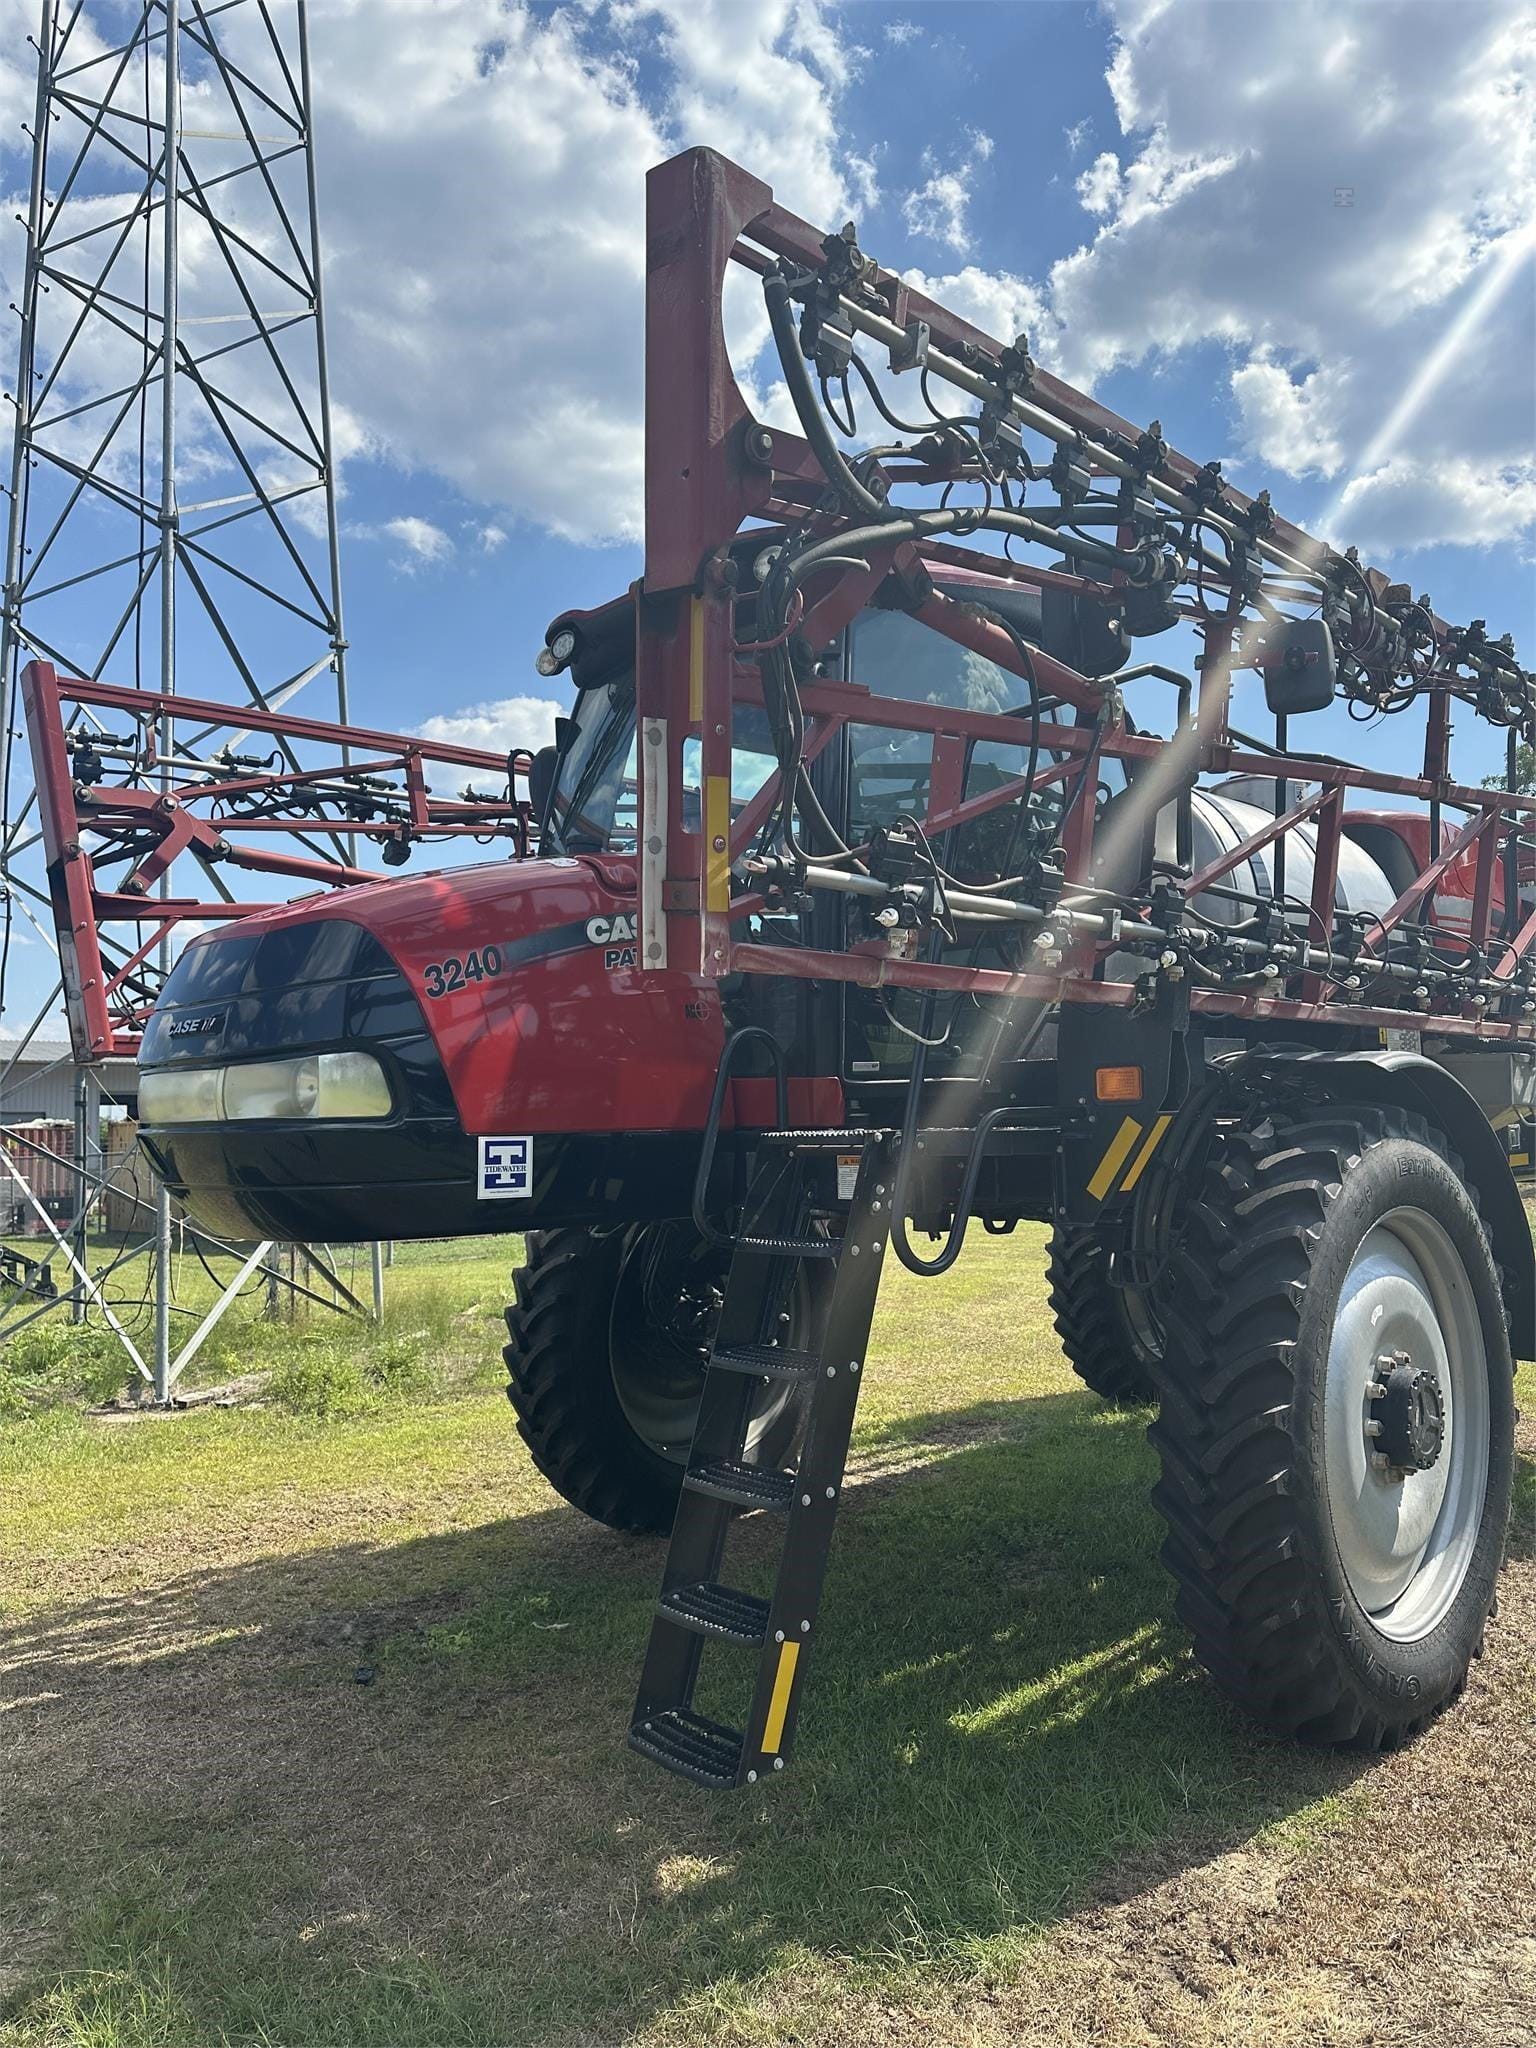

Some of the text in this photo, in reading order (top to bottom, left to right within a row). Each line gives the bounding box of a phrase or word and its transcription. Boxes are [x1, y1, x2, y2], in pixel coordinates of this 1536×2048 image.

[585, 913, 638, 944] CA
[424, 945, 502, 998] 3240
[168, 1019, 201, 1036] CASE
[484, 1165, 527, 1173] TIDEWATER
